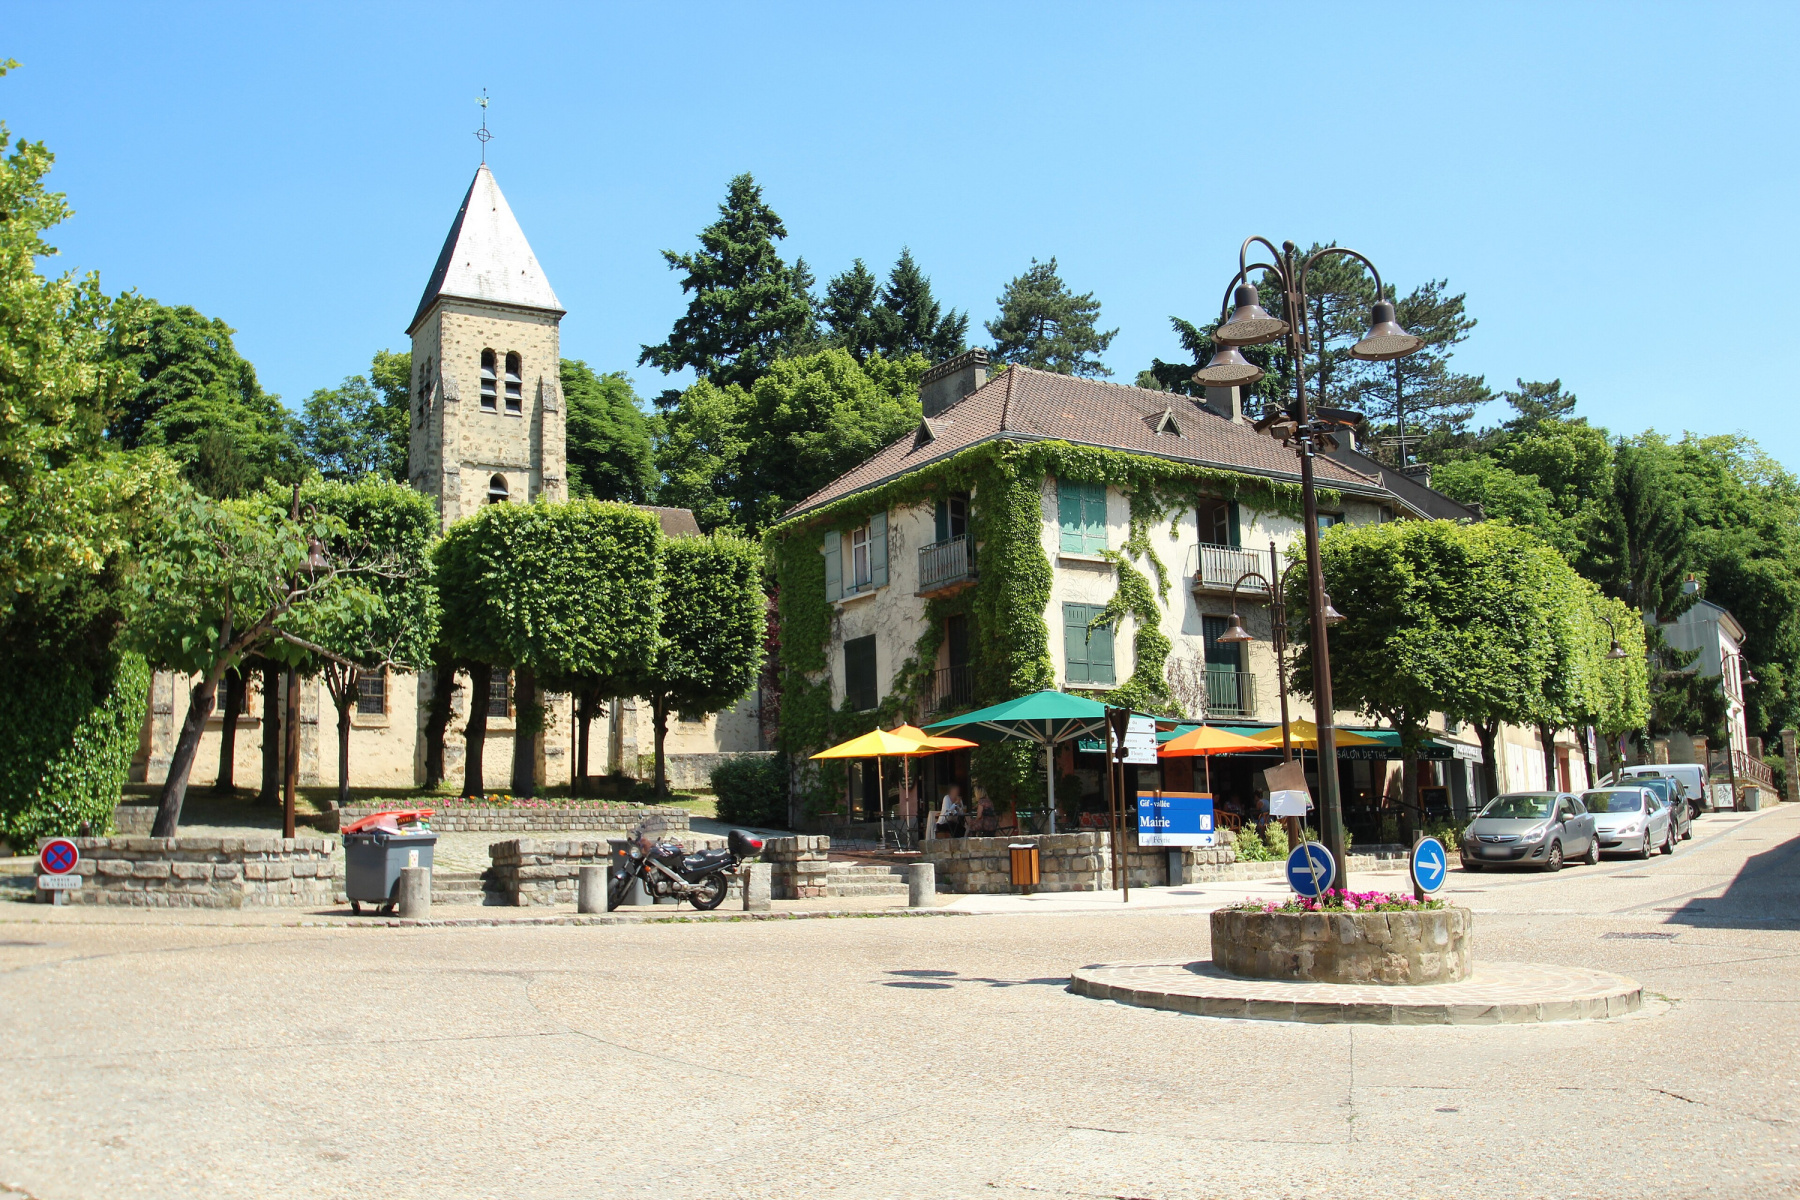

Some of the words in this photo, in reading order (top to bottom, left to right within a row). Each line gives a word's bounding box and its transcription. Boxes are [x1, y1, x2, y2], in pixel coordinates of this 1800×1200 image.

[1337, 749, 1360, 759] SALON
[1362, 749, 1372, 759] DE
[1140, 799, 1150, 807] Gif
[1153, 800, 1170, 808] vallée
[1140, 815, 1171, 827] Mairie
